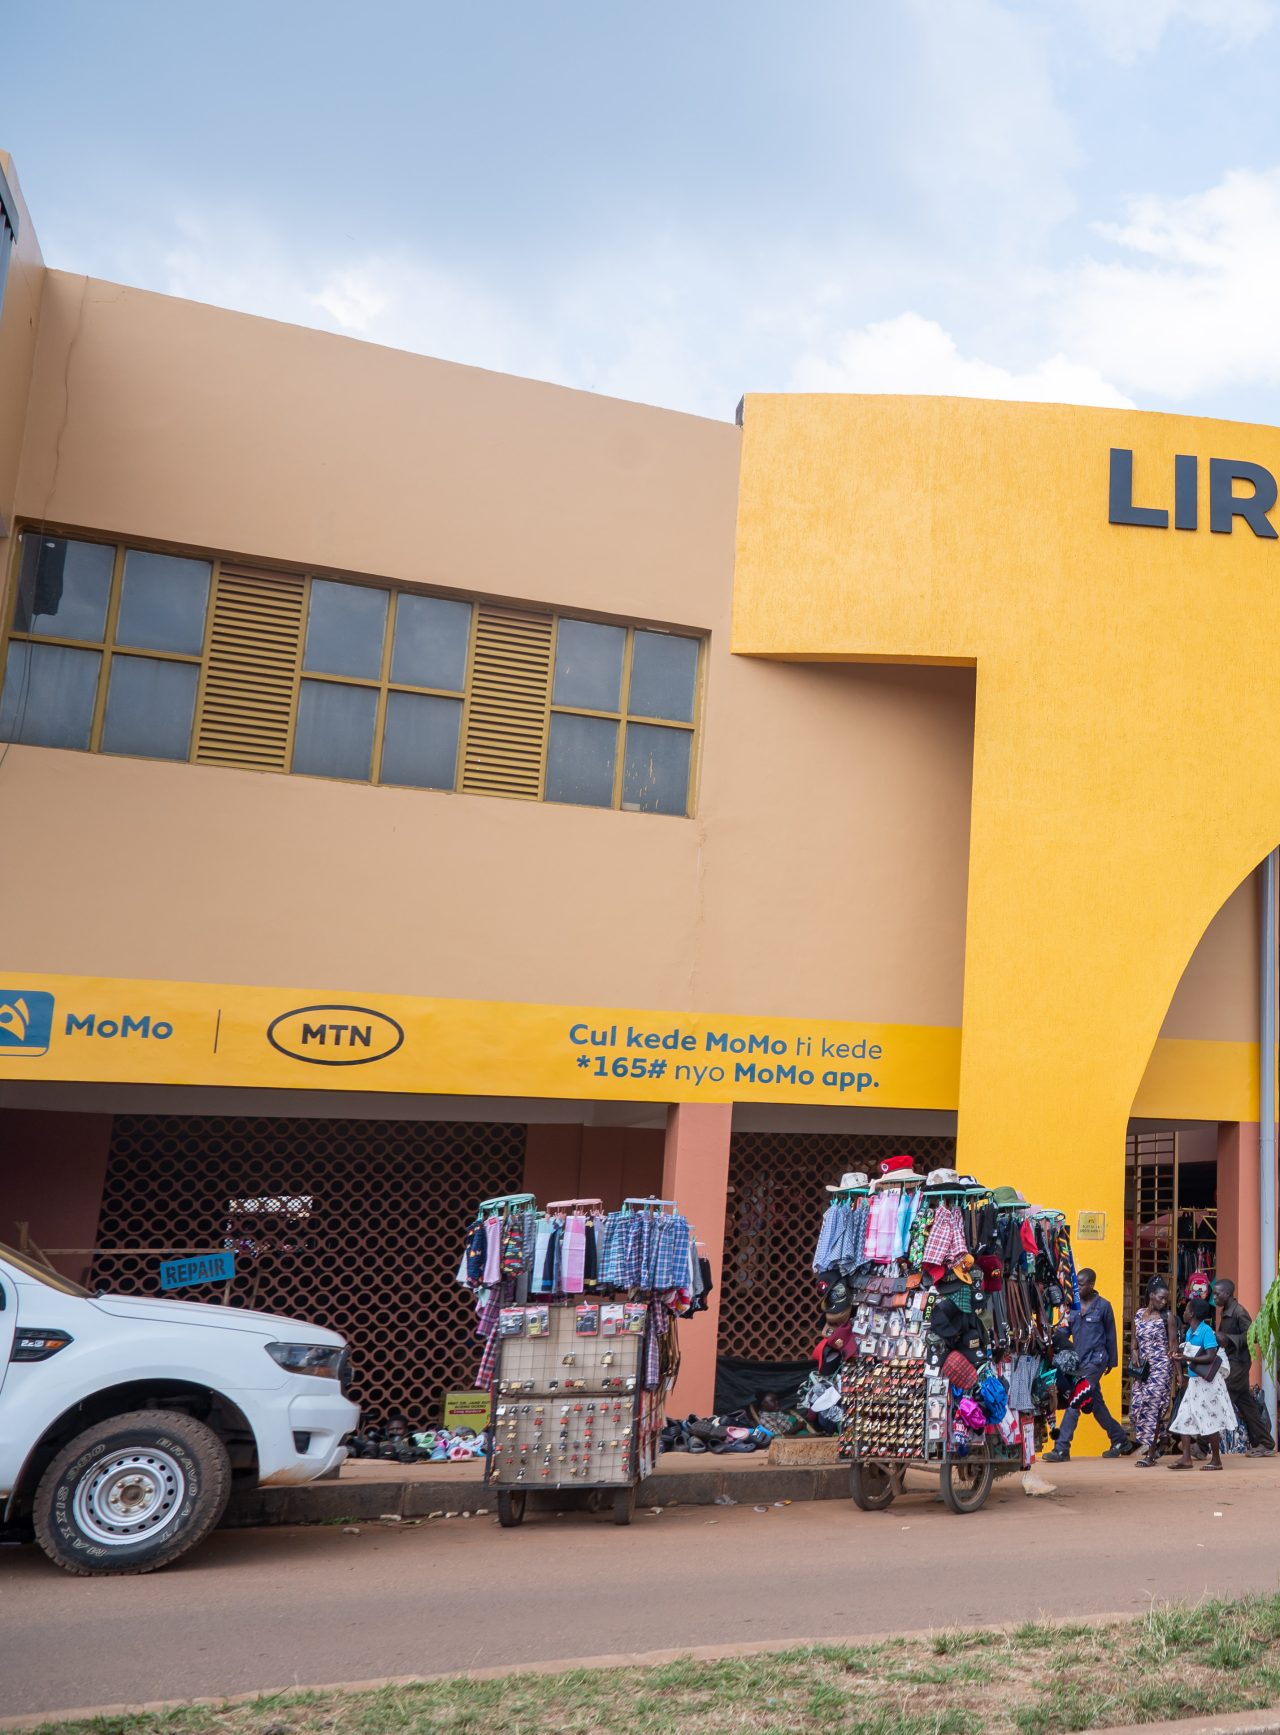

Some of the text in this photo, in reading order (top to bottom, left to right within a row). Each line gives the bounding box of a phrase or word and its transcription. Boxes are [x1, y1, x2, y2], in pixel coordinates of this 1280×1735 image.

[65, 1013, 173, 1040] MoMo
[301, 1023, 372, 1047] MTN
[569, 1024, 883, 1060] Cul kede MoMo ti kede
[675, 1063, 725, 1087] nyo
[734, 1063, 815, 1086] MoMo
[822, 1070, 880, 1092] app.
[165, 1258, 226, 1284] REPAIR
[156, 1437, 198, 1497] BRAVO
[56, 1486, 108, 1557] MAXXIS
